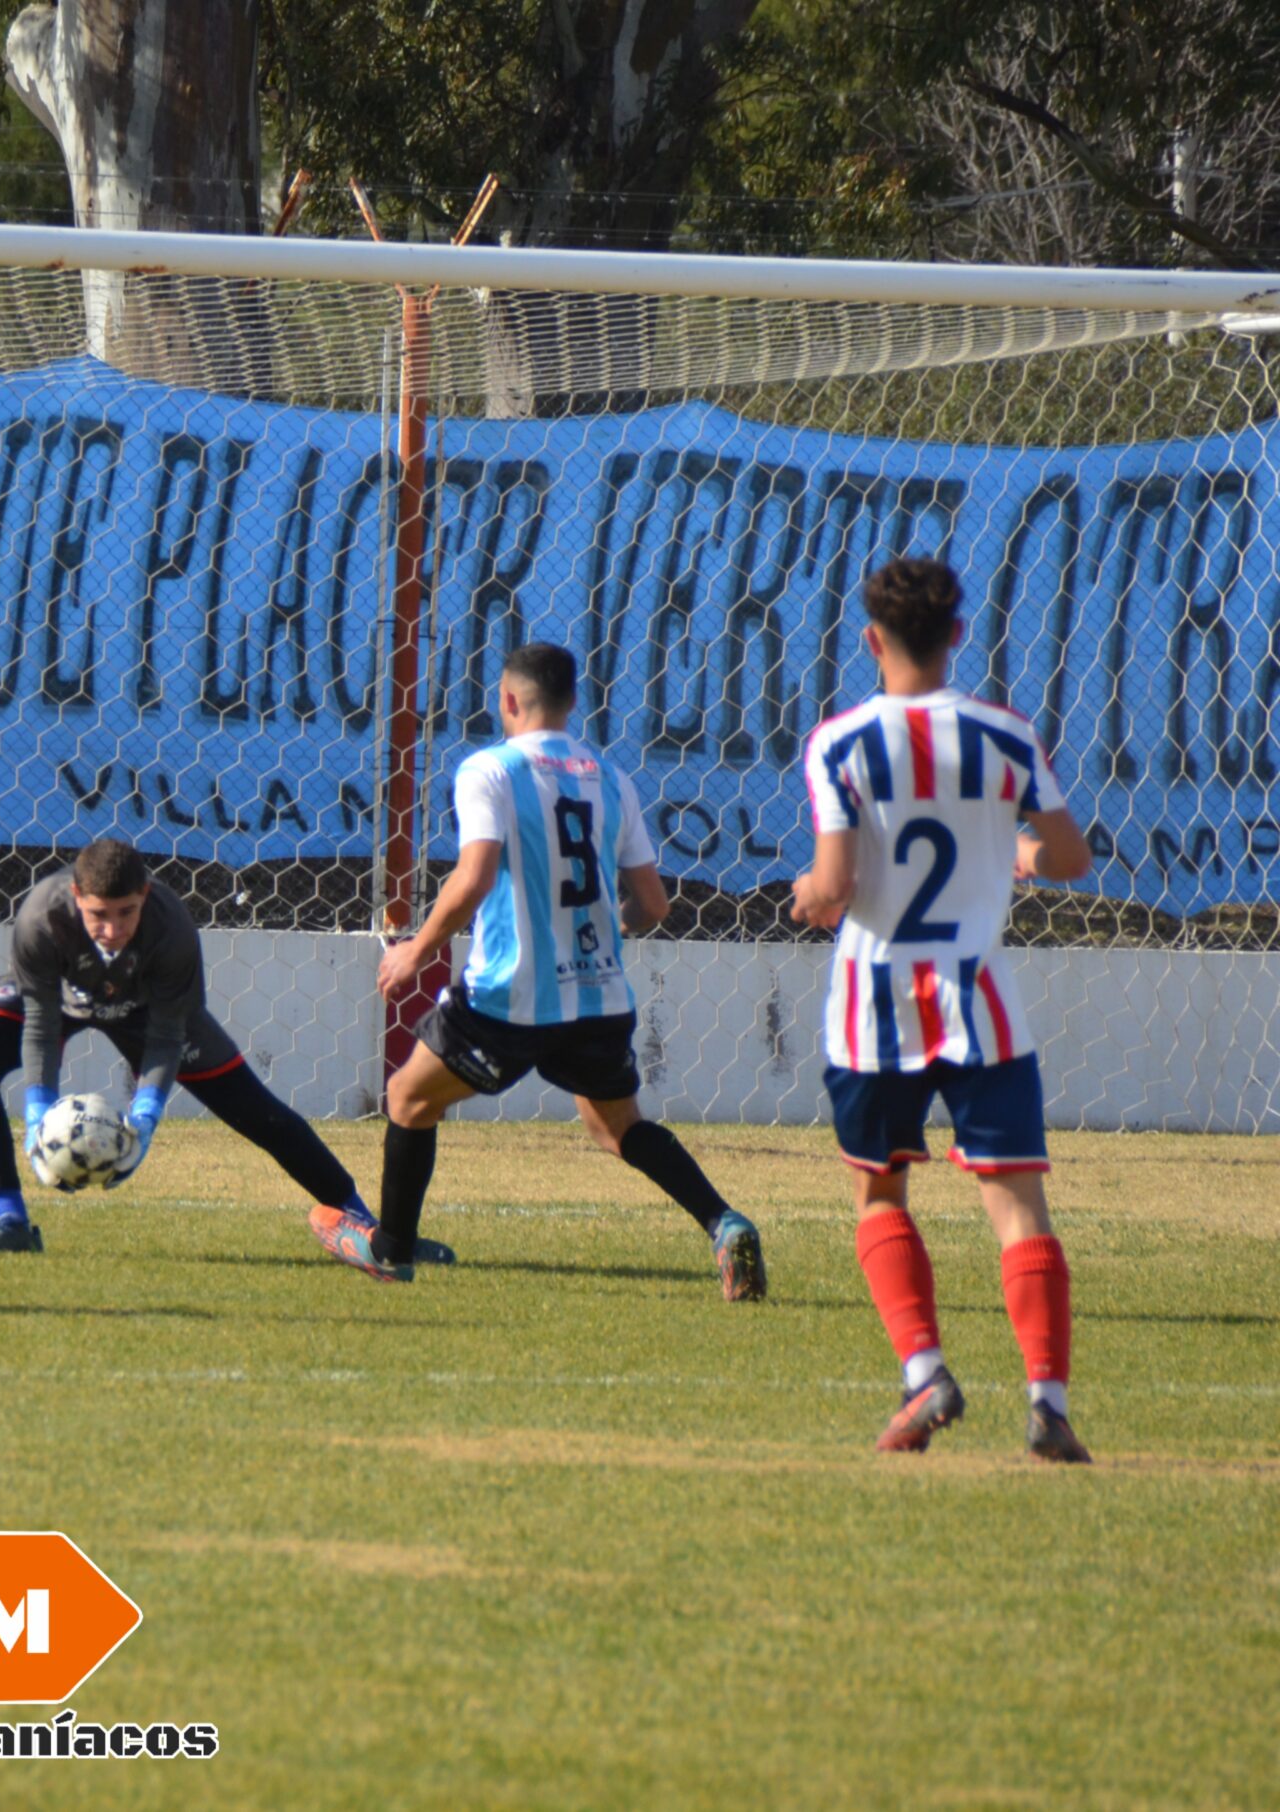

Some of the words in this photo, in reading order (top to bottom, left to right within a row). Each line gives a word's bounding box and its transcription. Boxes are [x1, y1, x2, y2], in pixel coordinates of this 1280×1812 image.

[137, 432, 550, 737] PLACER
[588, 450, 966, 764] VERT
[58, 763, 310, 834] VILLA
[554, 795, 601, 908] 9
[890, 817, 959, 943] 2
